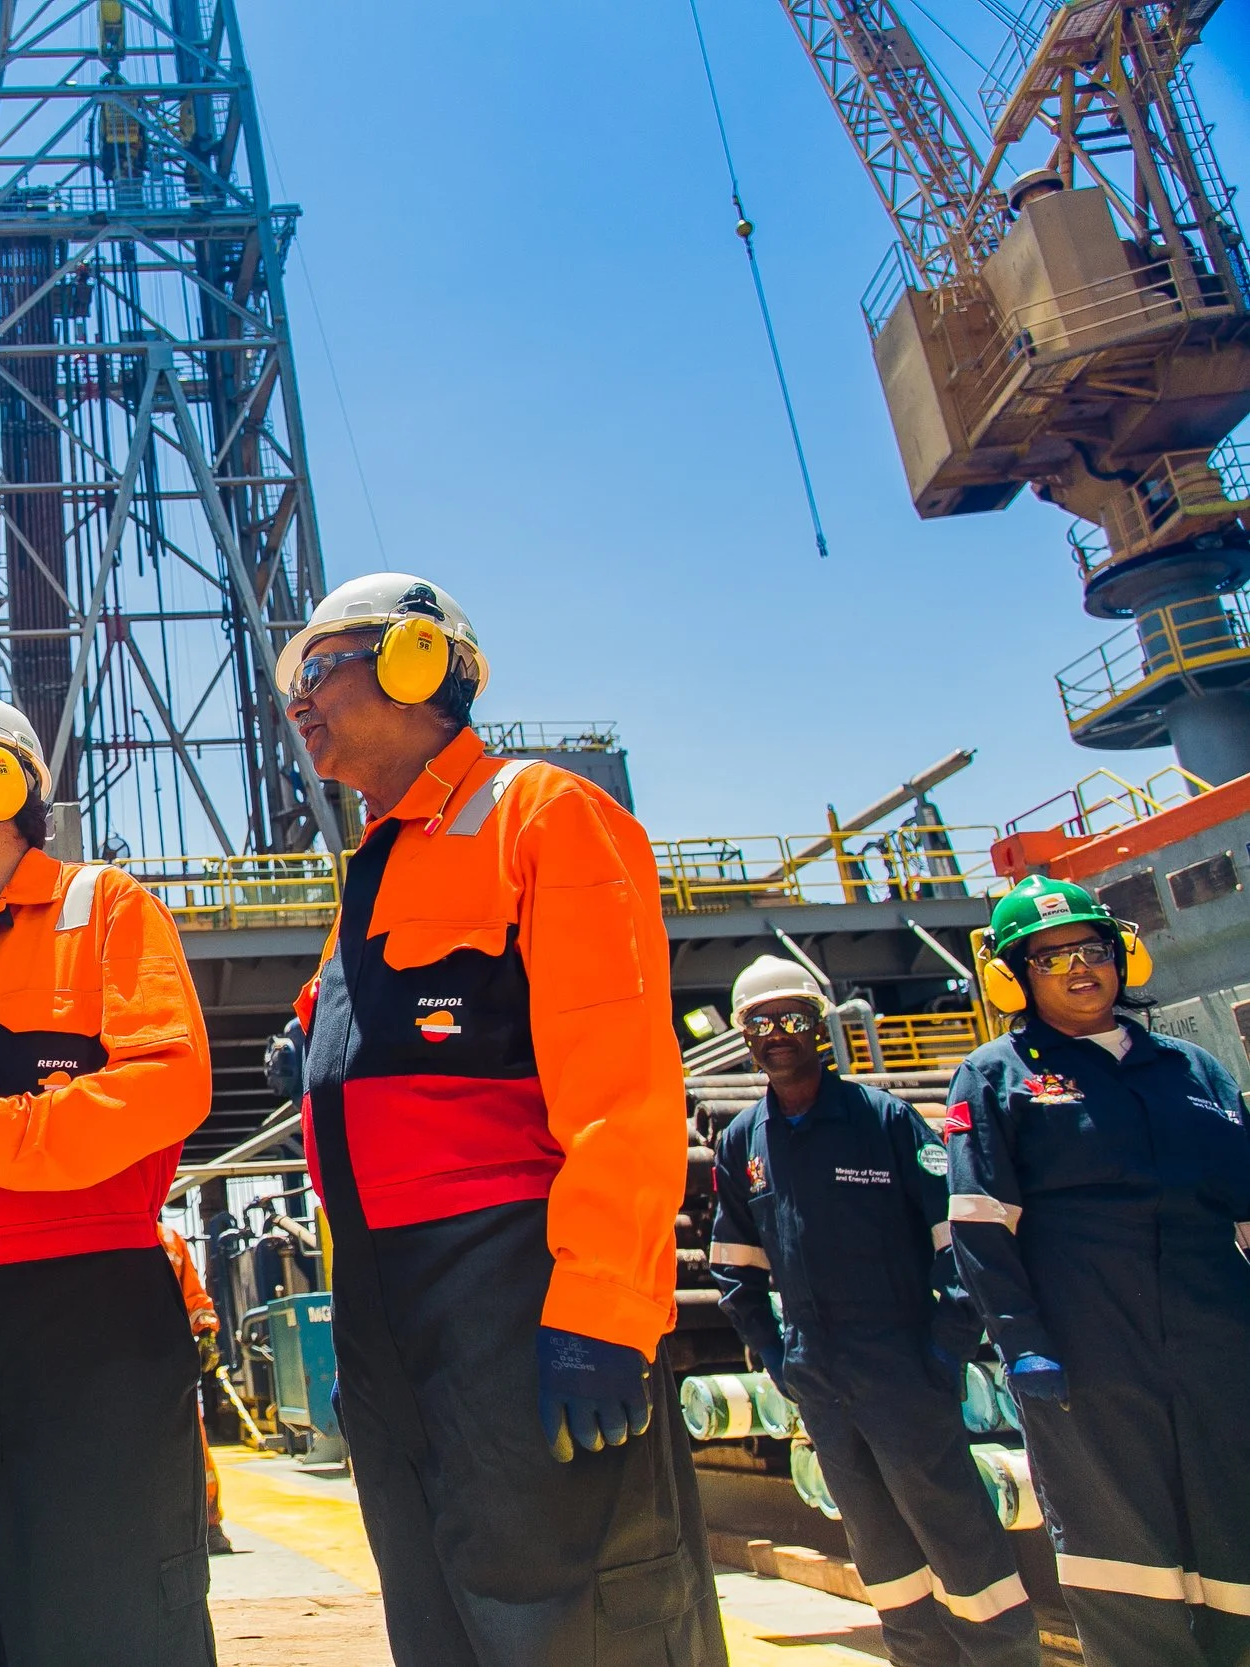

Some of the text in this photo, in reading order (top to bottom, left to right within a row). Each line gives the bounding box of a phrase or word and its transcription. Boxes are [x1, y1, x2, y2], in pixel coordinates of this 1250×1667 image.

[419, 641, 430, 650] 98
[1042, 908, 1070, 917] REPSOL
[417, 997, 463, 1007] REPSOL
[1169, 1016, 1198, 1037] LINE
[37, 1059, 79, 1069] REPSOL
[835, 1167, 860, 1177] Ministry
[869, 1169, 890, 1177] Energy
[848, 1175, 870, 1184] Energy
